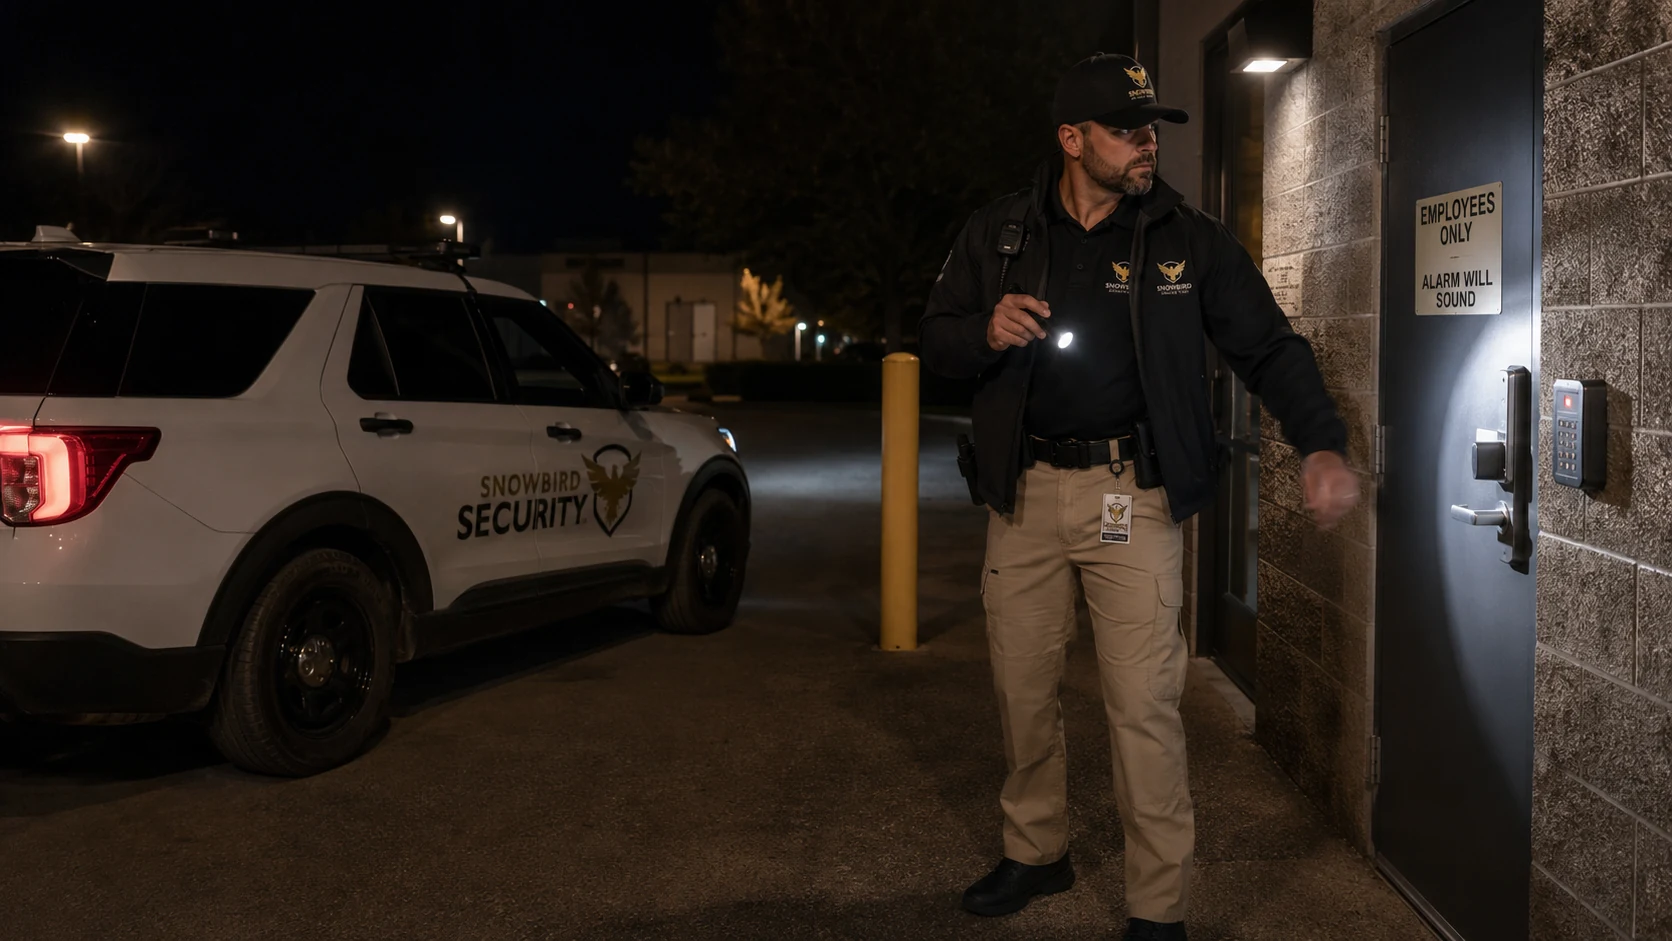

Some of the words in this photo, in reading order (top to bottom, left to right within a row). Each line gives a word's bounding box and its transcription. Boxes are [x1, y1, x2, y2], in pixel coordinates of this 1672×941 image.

[1421, 192, 1495, 225] EMPLOYEES
[1440, 221, 1472, 245] ONLY
[1422, 272, 1460, 290] ALARM
[1464, 269, 1493, 287] WILL
[1436, 291, 1476, 308] SOUND
[481, 471, 581, 498] SNOWBIRD
[457, 495, 588, 540] SECURITY
